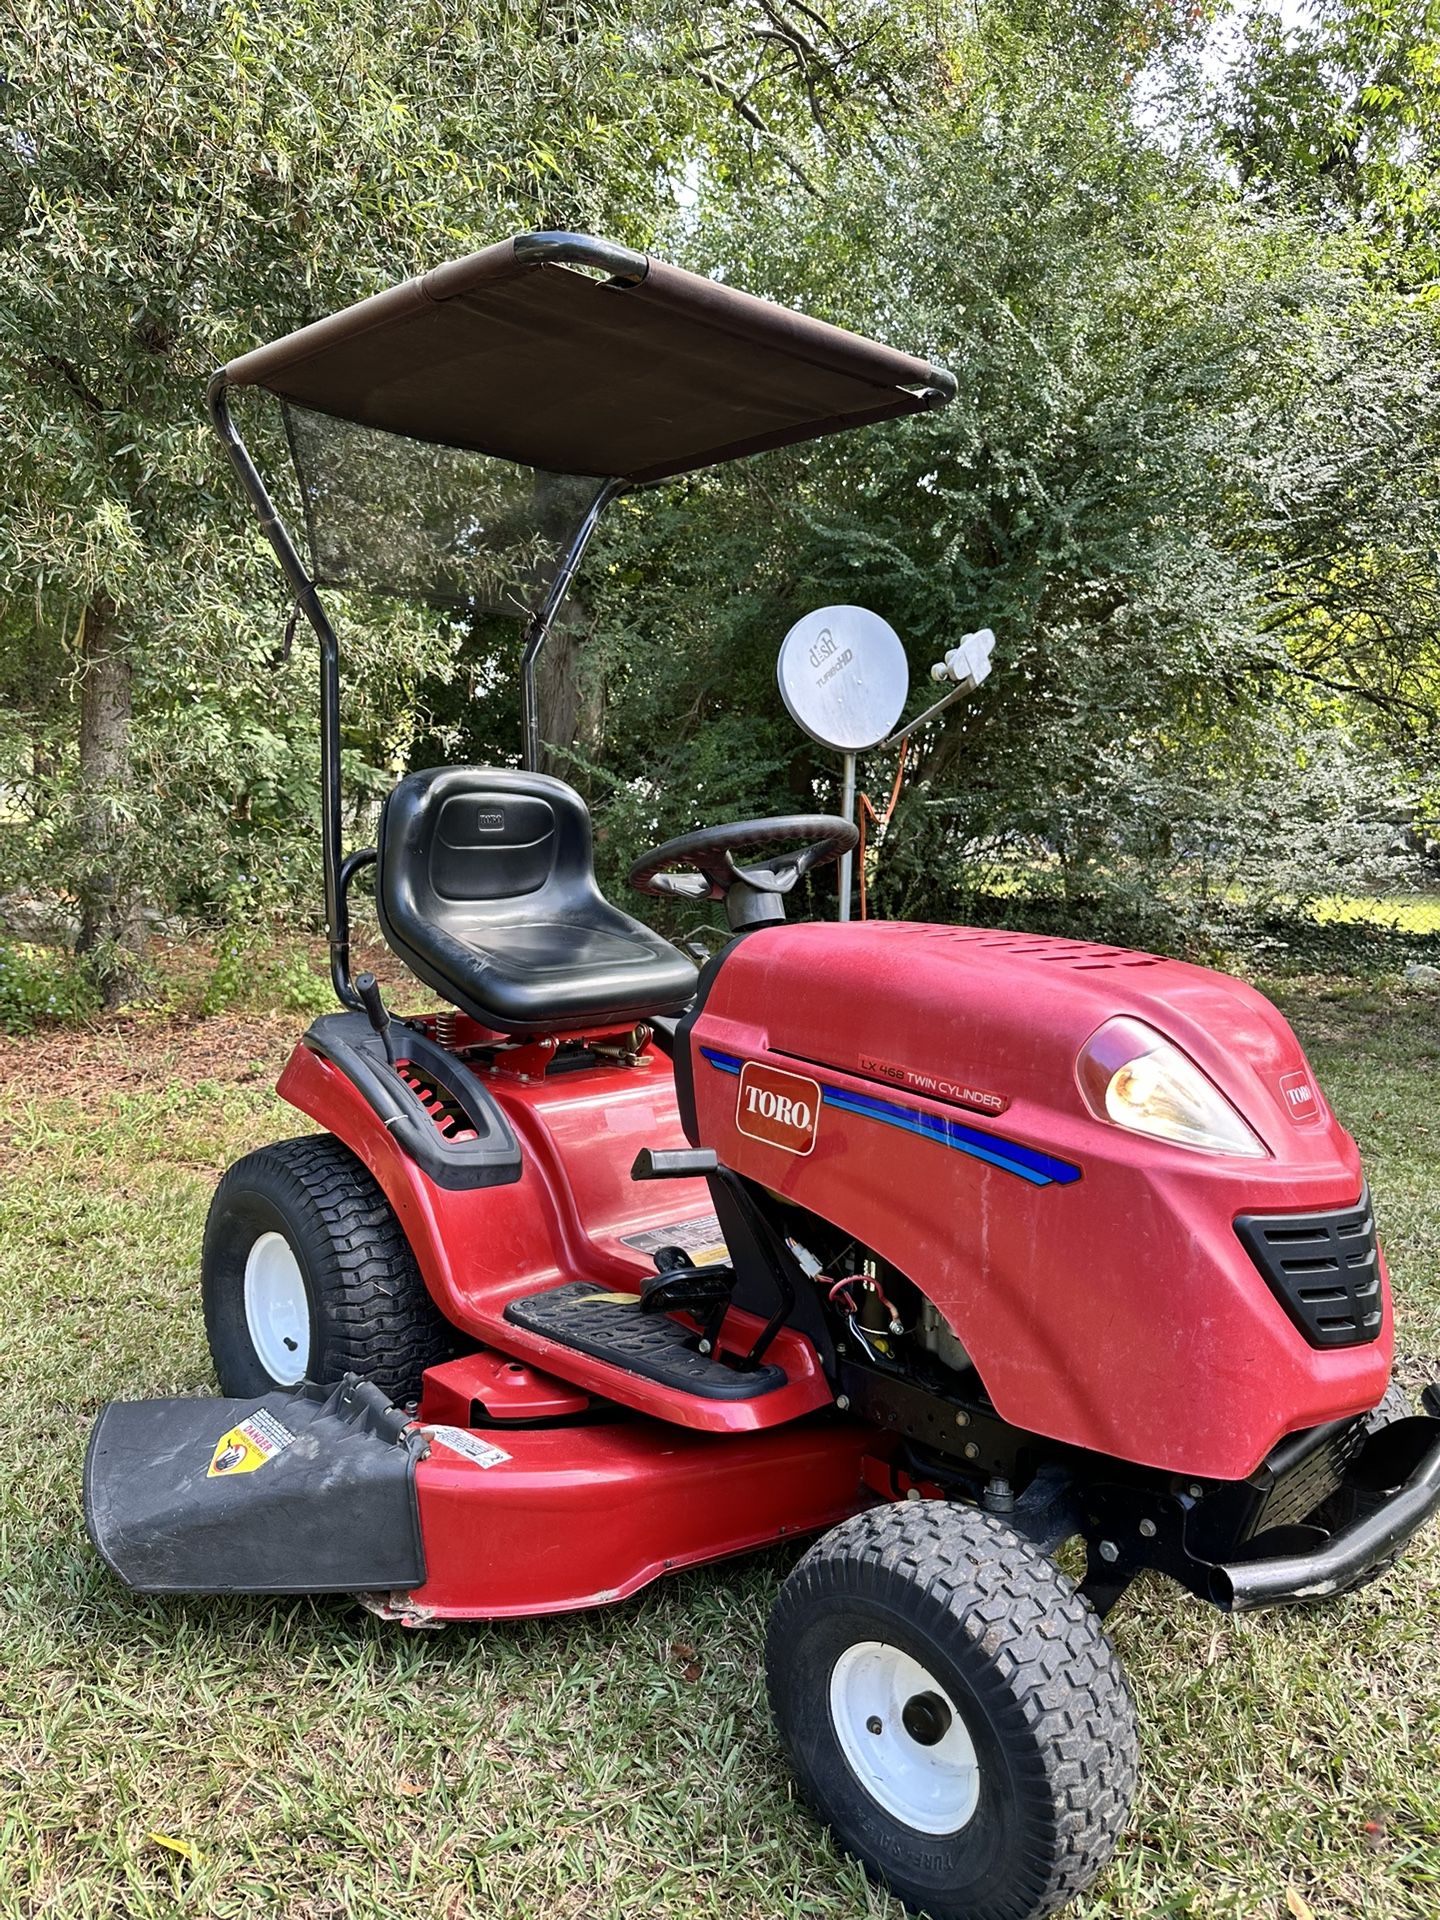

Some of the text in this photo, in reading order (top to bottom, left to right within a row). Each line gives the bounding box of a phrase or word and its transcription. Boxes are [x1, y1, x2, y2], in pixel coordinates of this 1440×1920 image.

[809, 634, 838, 668] dish
[861, 1059, 1003, 1109] LX 468 TWIN CYLINDER
[745, 1085, 811, 1129] TORO
[243, 1424, 273, 1452] DANGER
